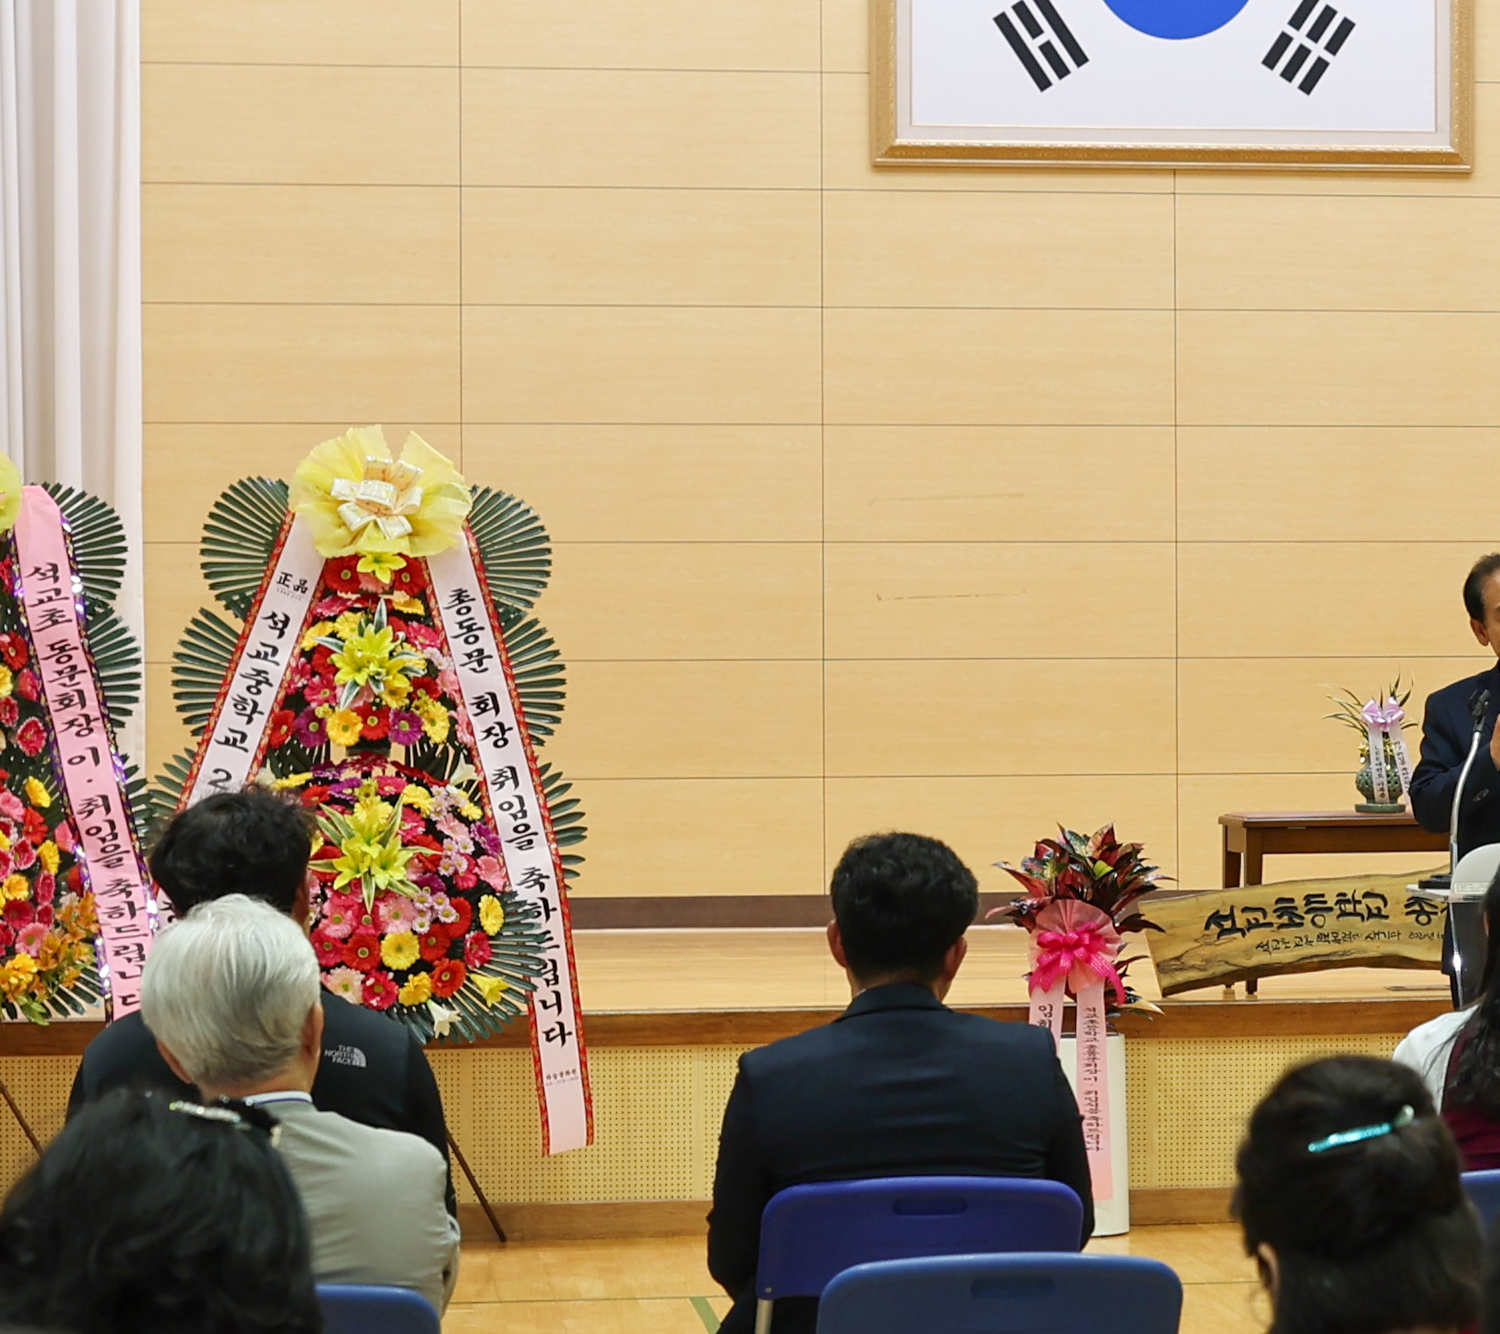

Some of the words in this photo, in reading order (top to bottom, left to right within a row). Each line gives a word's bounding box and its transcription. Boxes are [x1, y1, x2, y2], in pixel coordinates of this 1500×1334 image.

[24, 562, 73, 633] 석교초
[276, 571, 309, 595] 正品
[40, 639, 100, 738] 동문회장
[214, 610, 292, 753] 석교중학교
[490, 765, 539, 851] 취임을
[1204, 888, 1391, 940] 석교초등학교
